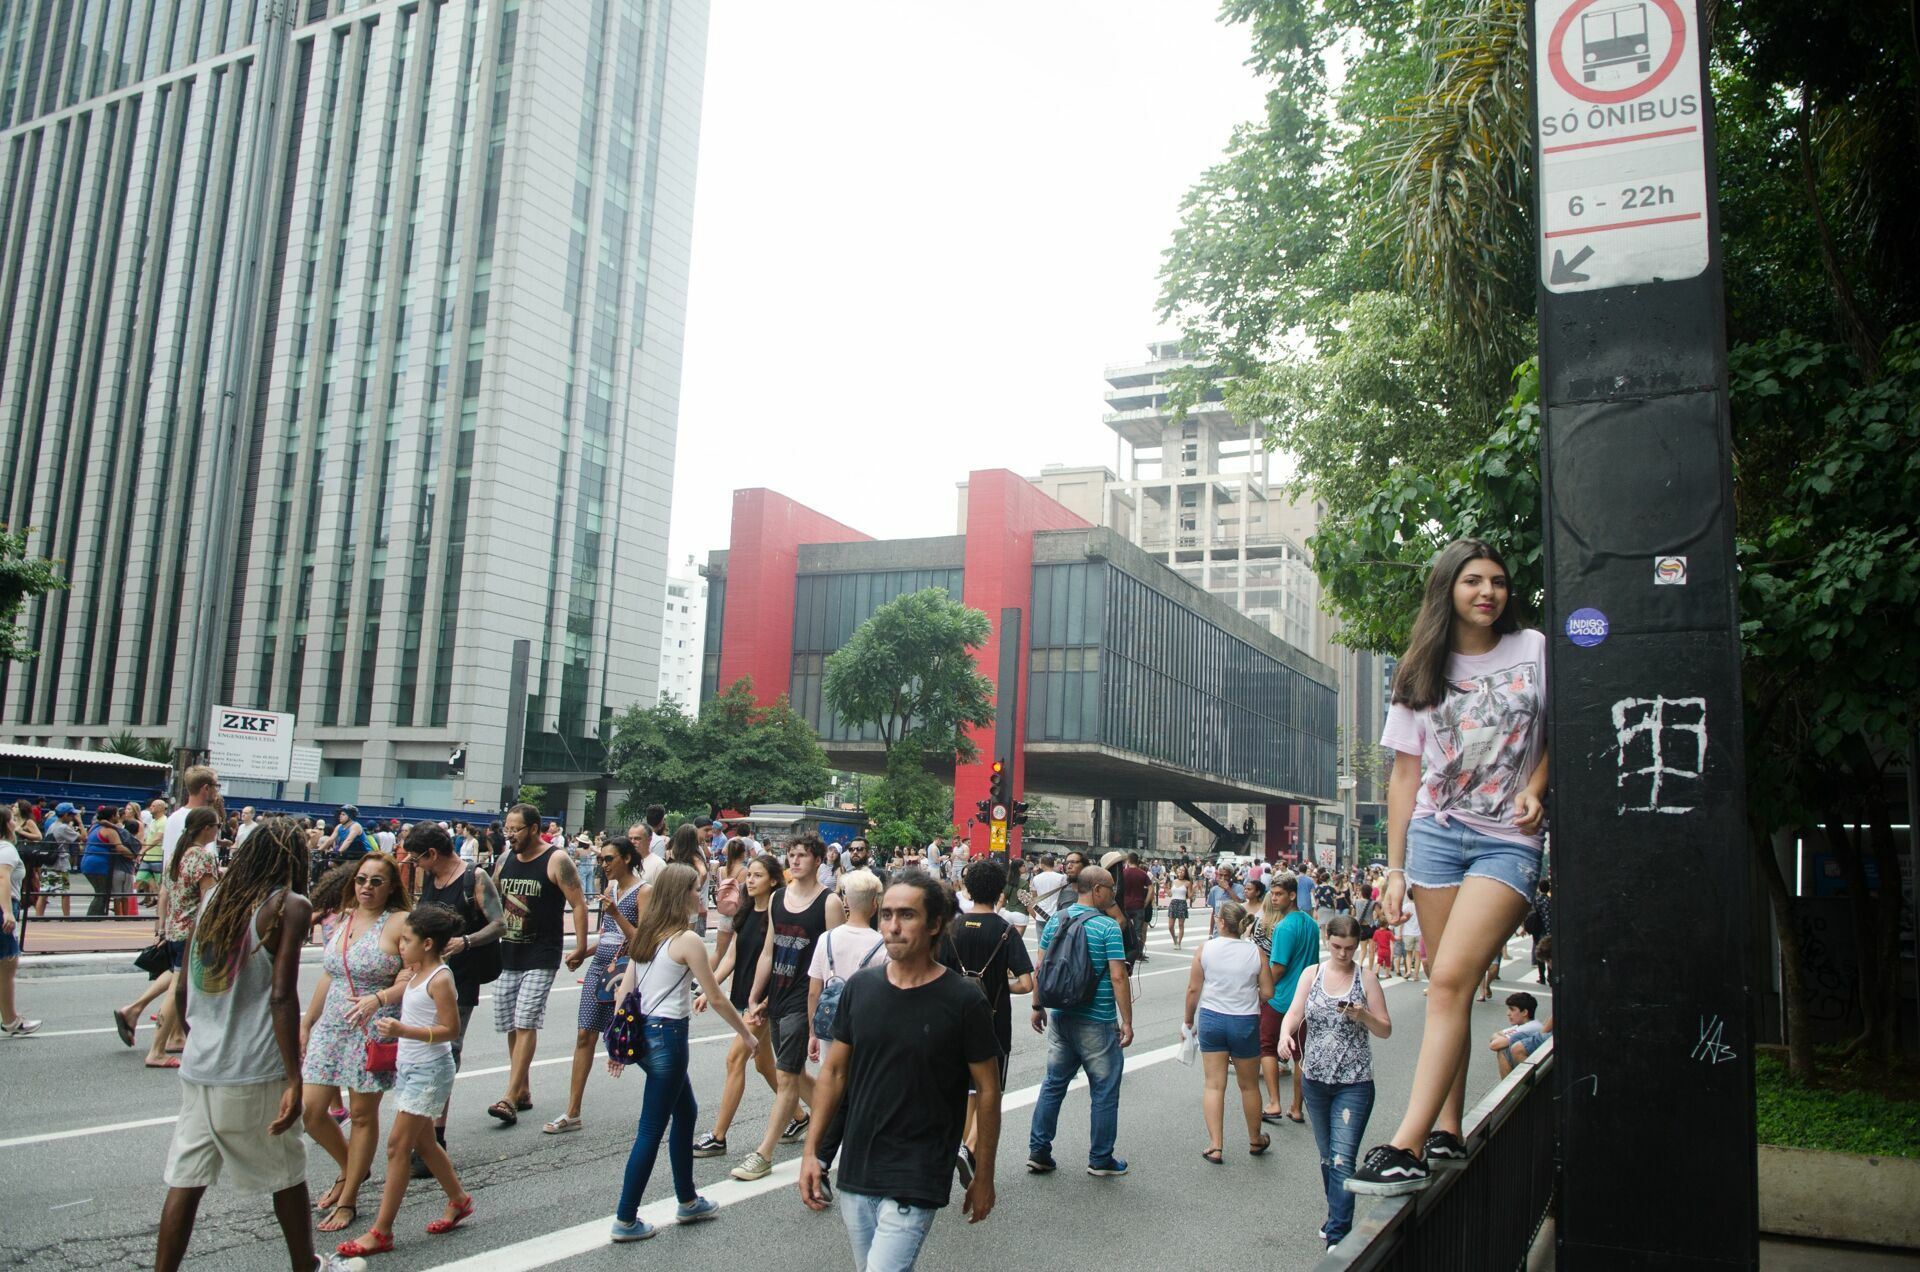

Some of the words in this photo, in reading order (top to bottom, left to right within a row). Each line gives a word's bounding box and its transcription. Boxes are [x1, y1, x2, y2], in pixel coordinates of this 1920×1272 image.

[1542, 108, 1578, 136] SÓ
[1587, 95, 1697, 130] ÔNIBUS
[1568, 196, 1584, 216] 6
[1621, 185, 1674, 210] 22h
[1569, 619, 1608, 630] INDIGO
[222, 714, 275, 732] ZKF
[218, 733, 258, 741] ENGENHARIA
